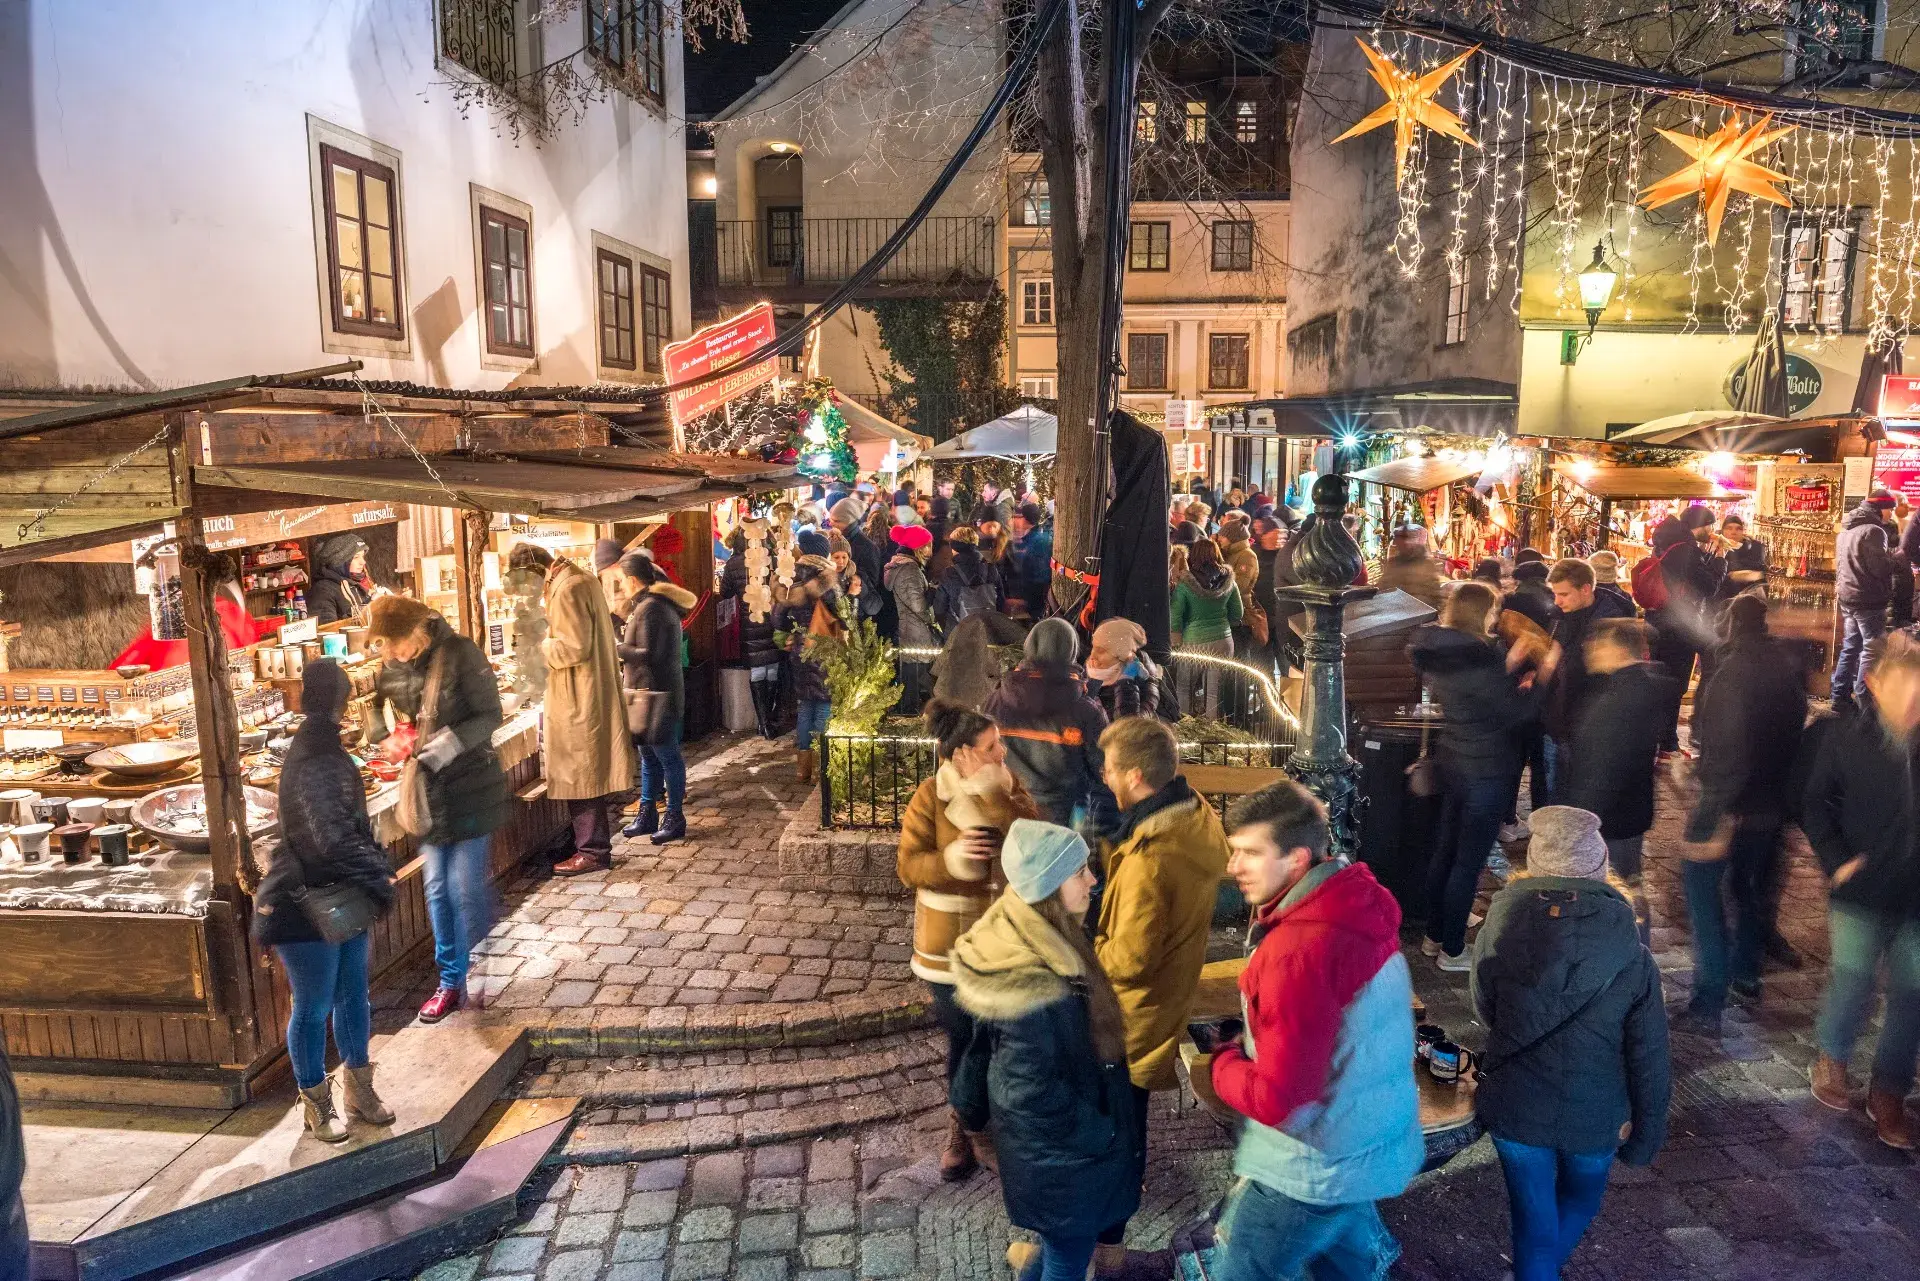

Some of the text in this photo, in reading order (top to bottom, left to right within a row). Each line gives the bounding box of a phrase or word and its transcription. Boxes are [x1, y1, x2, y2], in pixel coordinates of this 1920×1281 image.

[705, 328, 738, 349] Restaurant
[708, 346, 722, 357] Erde
[722, 341, 732, 352] und
[709, 350, 742, 371] Heisser
[1787, 375, 1820, 395] Bolte
[511, 525, 538, 535] salz
